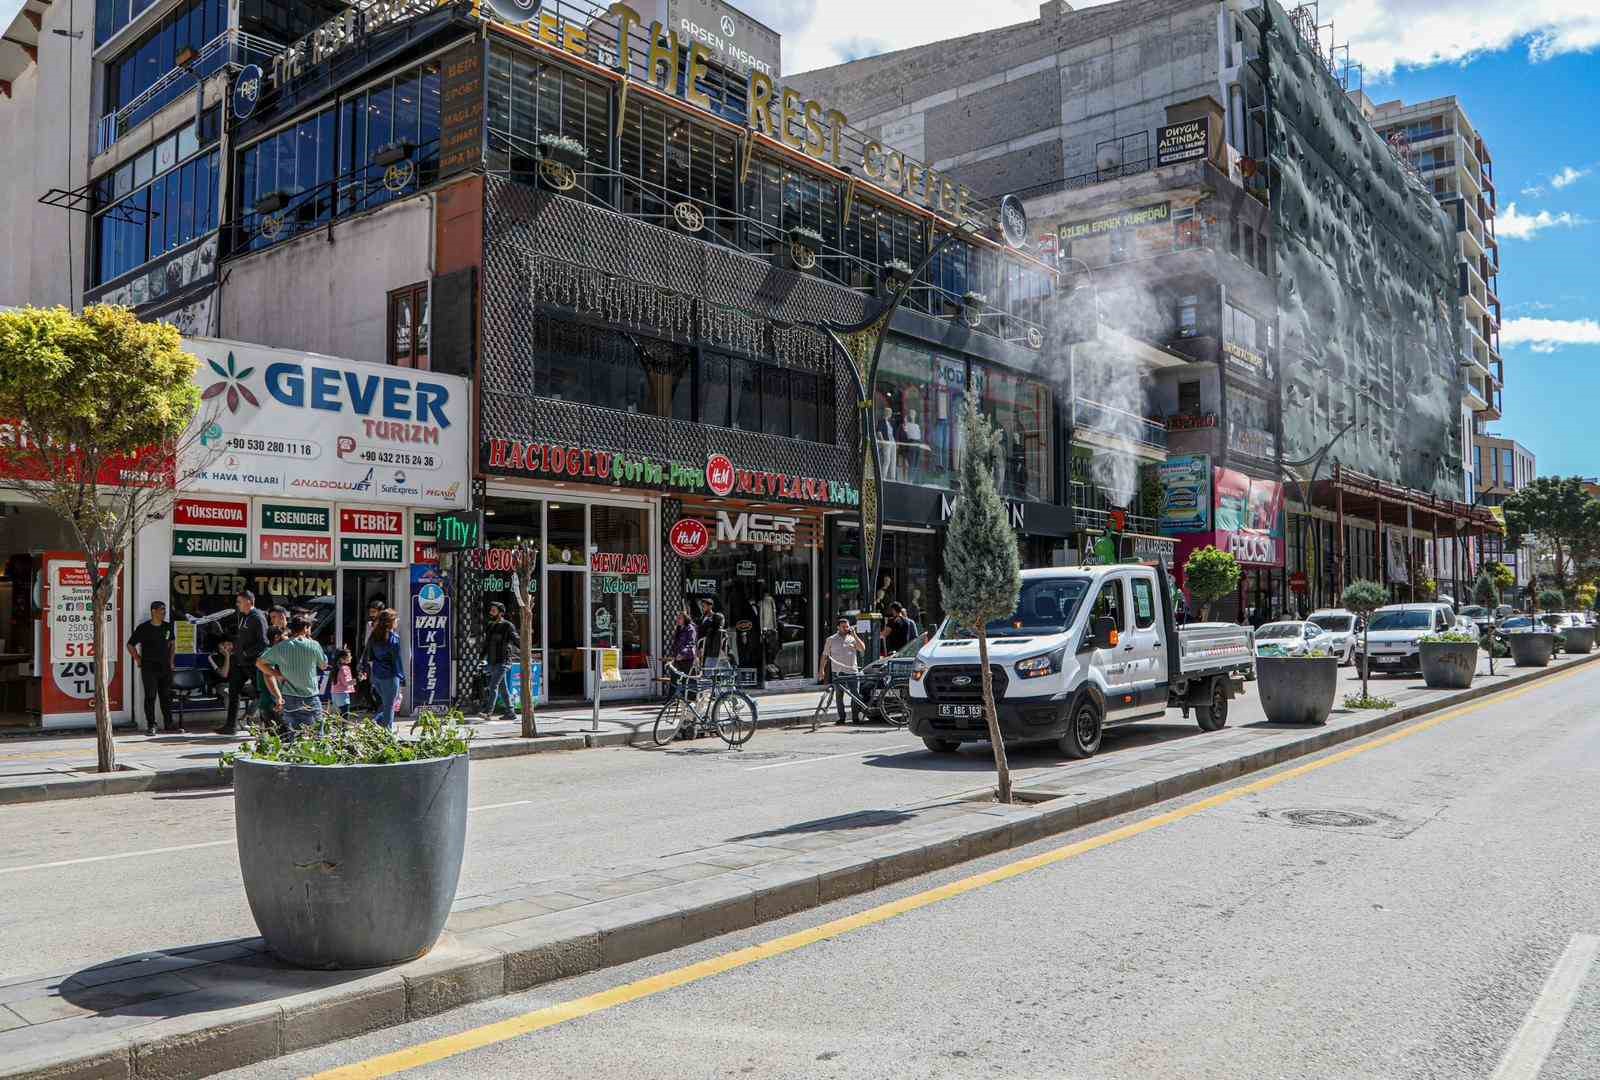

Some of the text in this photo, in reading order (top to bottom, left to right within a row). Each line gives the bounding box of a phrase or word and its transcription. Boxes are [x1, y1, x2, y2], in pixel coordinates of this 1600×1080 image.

[680, 18, 724, 51] ARSEN
[609, 2, 712, 111] THE
[749, 70, 848, 164] REST
[1166, 122, 1199, 138] DUYGU
[264, 362, 451, 429] GEVER
[226, 438, 312, 456] +90 530 280 11 16
[359, 451, 376, 462] +90
[212, 472, 238, 482] HAVA
[186, 505, 243, 521] YÜKSEKOVA
[273, 511, 326, 526] ESENDERE
[353, 512, 398, 532] TEBRİZ
[186, 536, 243, 553] ŞEMDİNLİ
[272, 540, 329, 560] DERECİK
[352, 541, 399, 560] URMİYE
[591, 553, 649, 575] MEVLANA
[173, 574, 247, 595] GEVER
